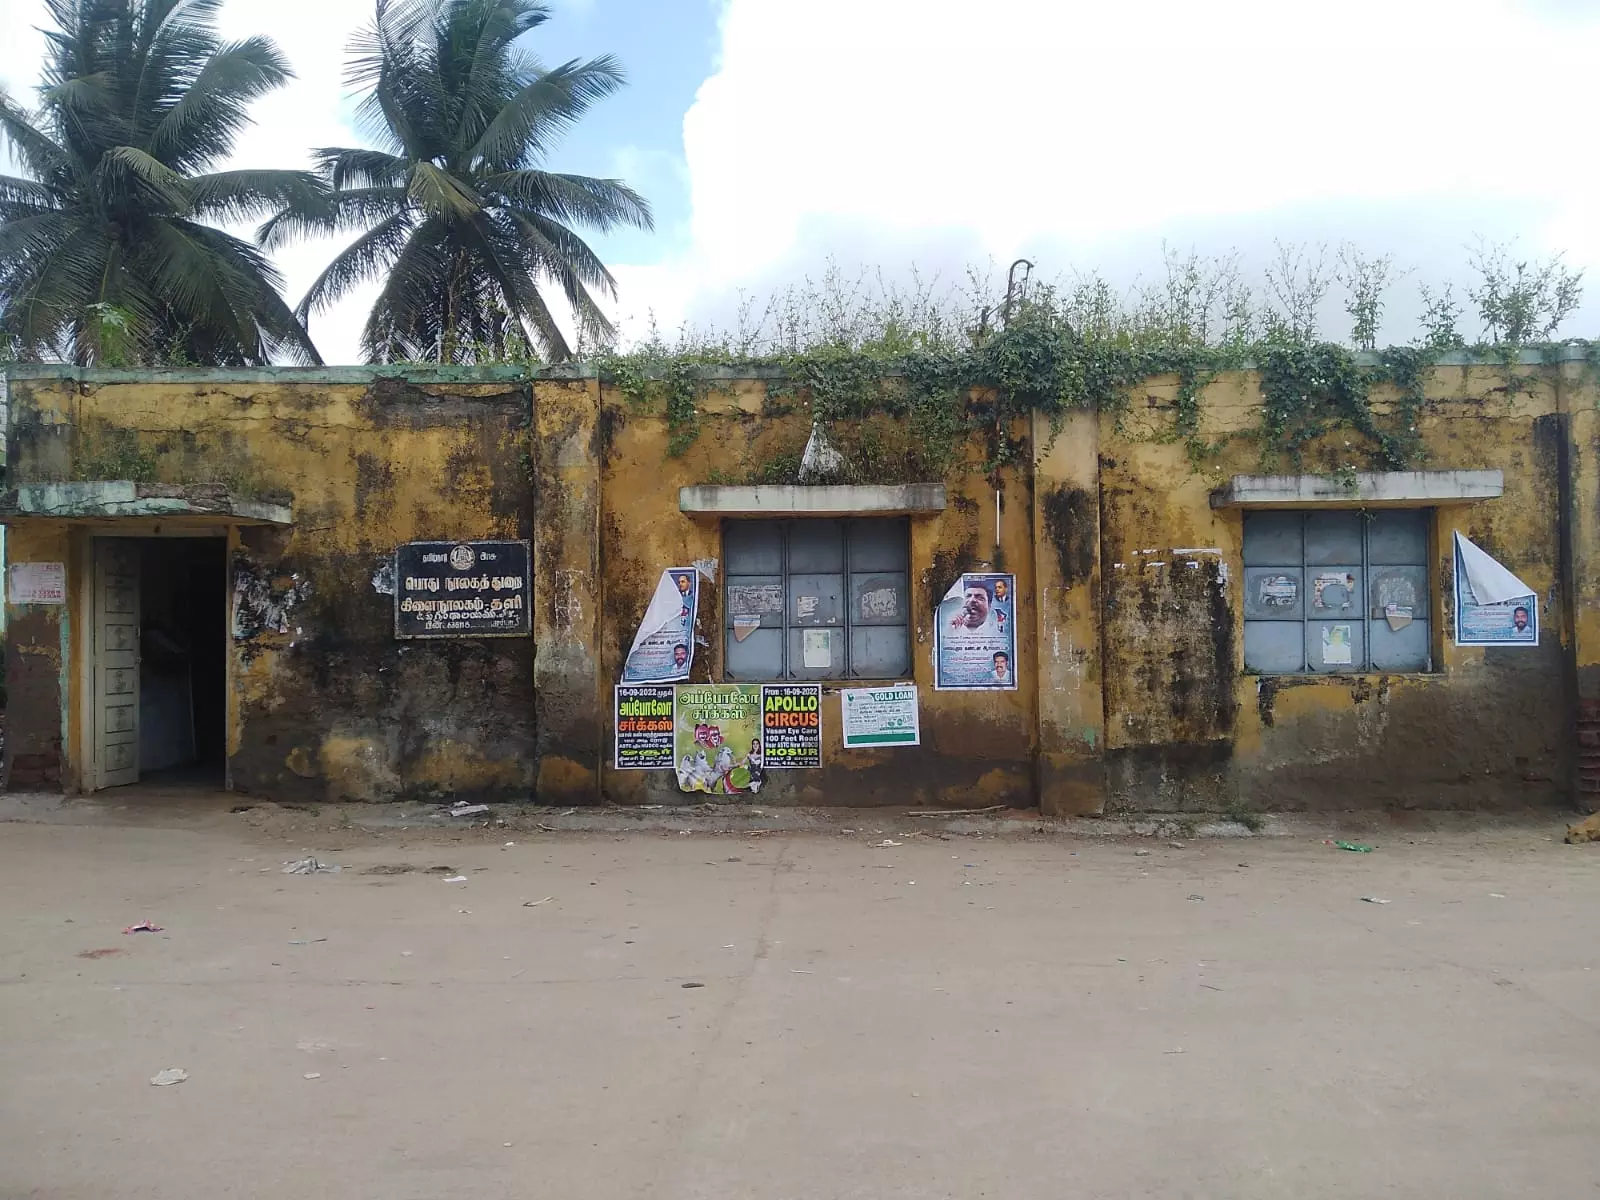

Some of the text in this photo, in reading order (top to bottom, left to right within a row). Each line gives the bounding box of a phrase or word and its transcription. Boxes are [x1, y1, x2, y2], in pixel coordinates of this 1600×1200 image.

[405, 576, 440, 593] பொது
[619, 688, 657, 697] 16-09-2022
[679, 689, 760, 705] அப்போலோ
[874, 692, 893, 701] GOLD
[894, 691, 913, 700] LOAN
[619, 696, 673, 717] அப்போலோ
[765, 696, 818, 711] APOLLO
[692, 704, 747, 720] சர்க்கஸ்
[765, 712, 818, 727] CIRCUS
[619, 716, 673, 732] சர்க்கஸ்
[765, 748, 818, 756] HOSUR
